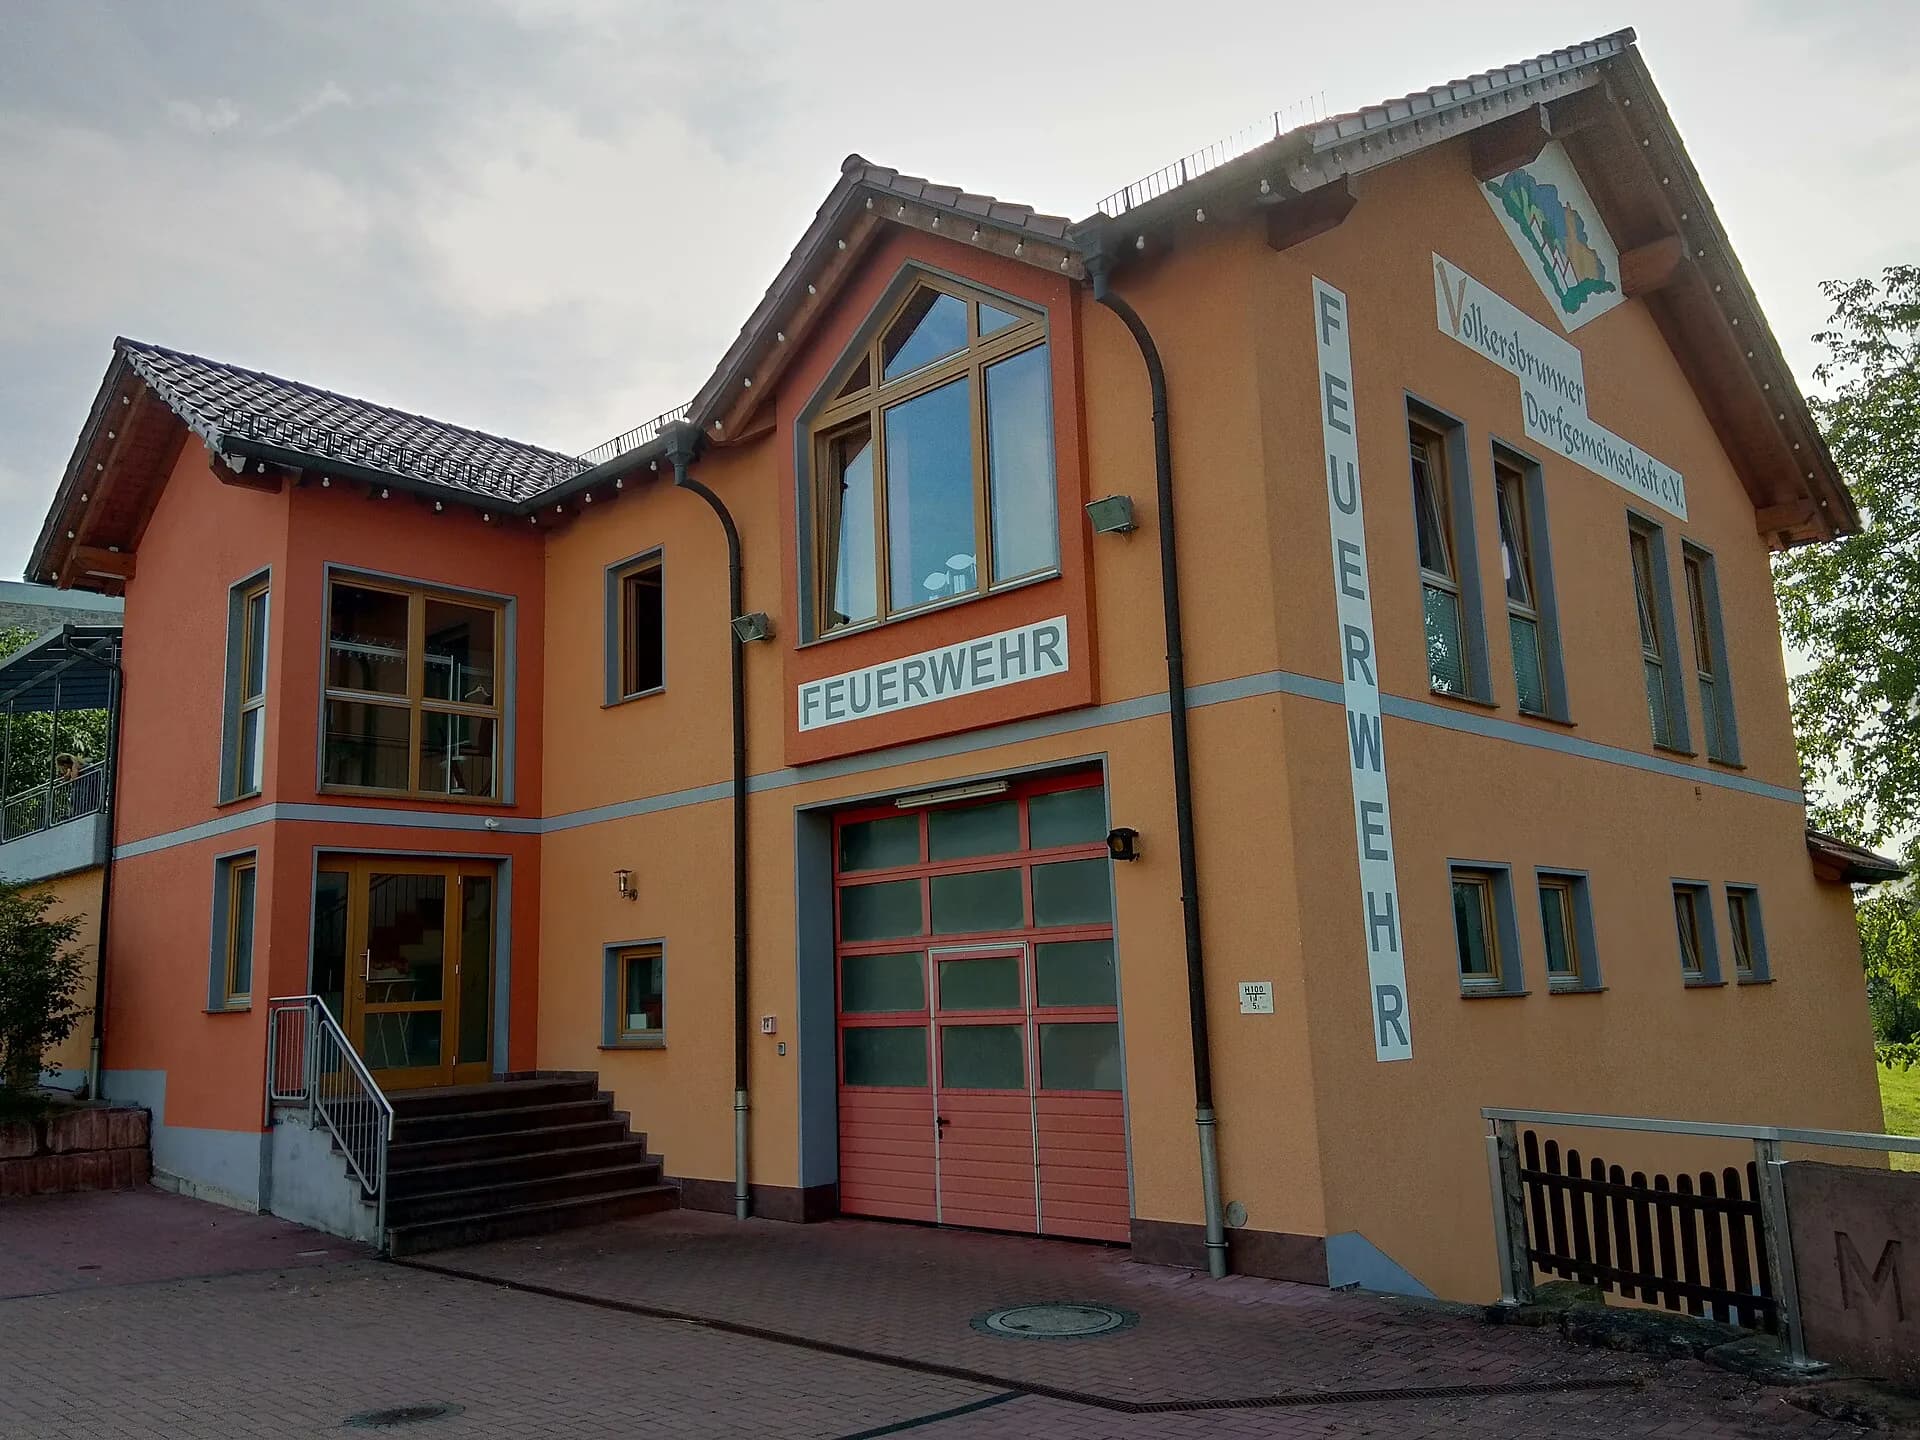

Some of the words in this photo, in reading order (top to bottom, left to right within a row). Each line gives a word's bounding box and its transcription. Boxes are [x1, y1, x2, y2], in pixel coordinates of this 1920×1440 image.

[1435, 261, 1583, 406] Volkersbrunner
[1524, 390, 1659, 496] Dorfgemeinschaft
[1660, 473, 1684, 509] e.V.
[803, 625, 1063, 726] FEUERWEHR
[1319, 290, 1408, 1048] FEUERWEHR
[1244, 985, 1264, 993] H100
[1834, 1230, 1905, 1323] M
